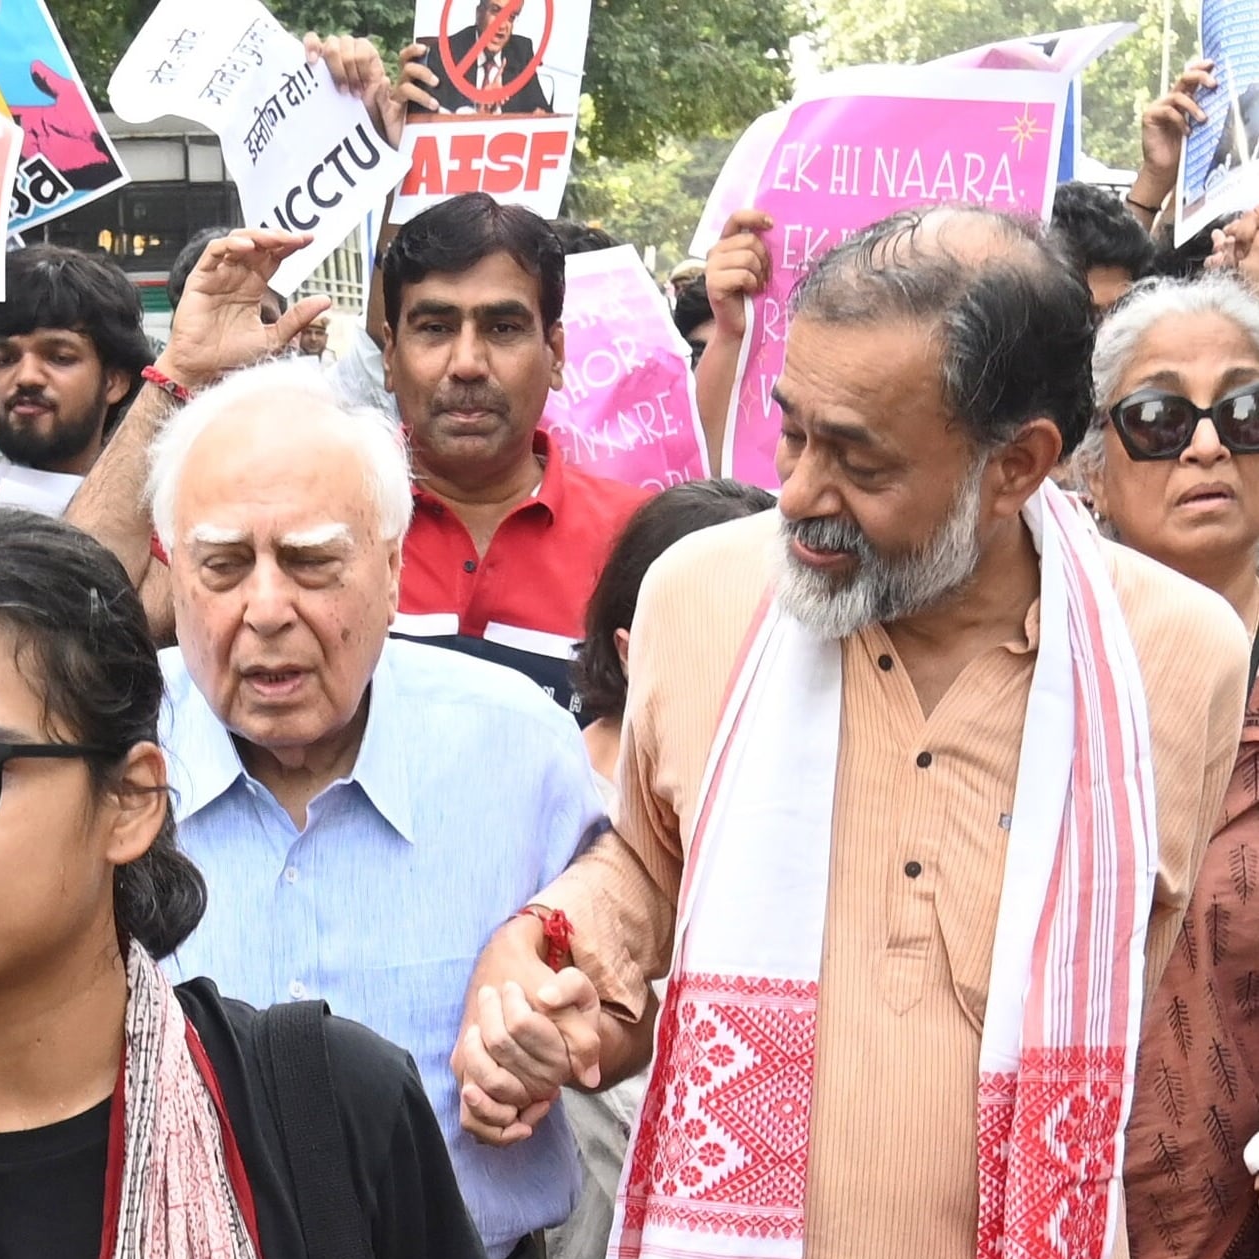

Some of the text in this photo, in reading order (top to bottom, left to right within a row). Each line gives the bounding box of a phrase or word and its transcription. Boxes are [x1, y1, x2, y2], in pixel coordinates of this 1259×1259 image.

[9, 157, 70, 217] sa
[399, 130, 569, 196] AISF
[772, 142, 1026, 203] EK HI NAARA.
[781, 223, 829, 272] EK
